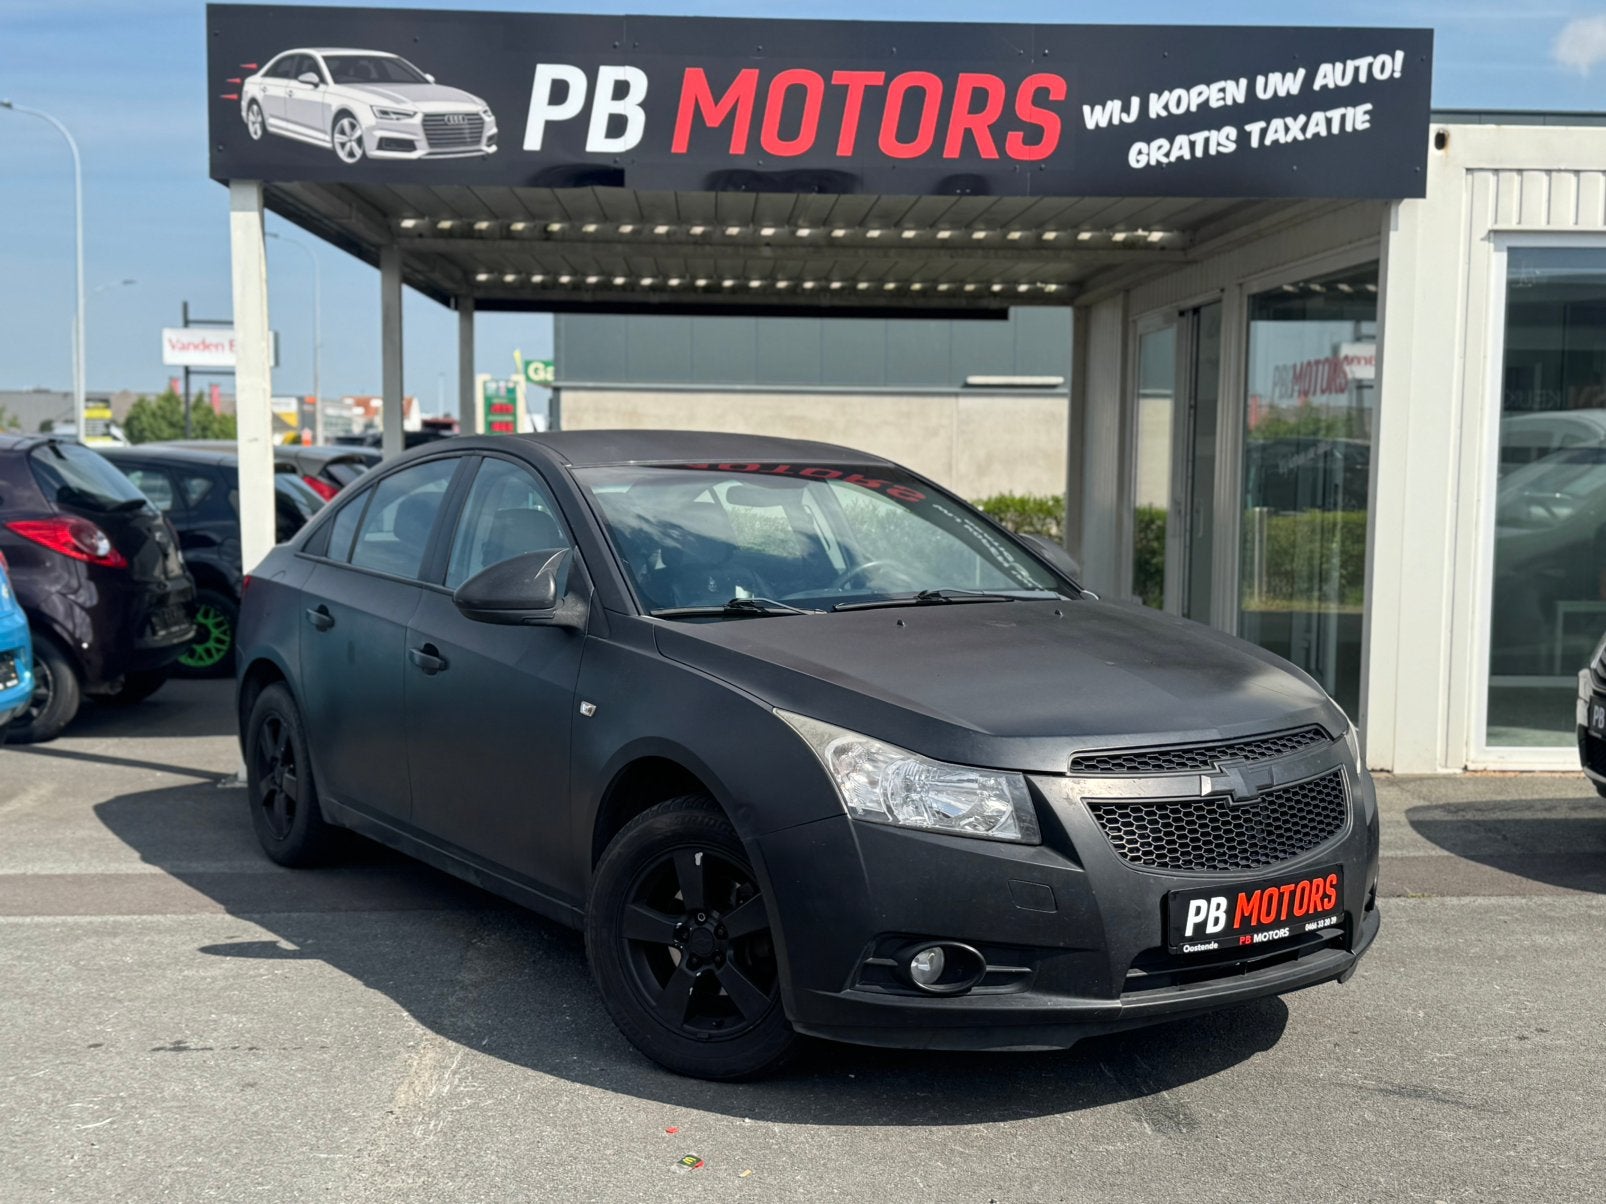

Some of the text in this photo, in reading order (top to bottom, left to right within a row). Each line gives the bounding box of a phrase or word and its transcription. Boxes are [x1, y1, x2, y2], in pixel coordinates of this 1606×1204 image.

[523, 63, 1068, 161] PB MOTORS
[1082, 49, 1405, 130] WIJ KOPEN UW AUTO!
[1128, 102, 1374, 169] GRATIS TAXATIE
[168, 337, 225, 352] Vanden
[1291, 356, 1349, 398] MOTORS
[1593, 705, 1605, 729] PB
[1184, 873, 1338, 937] PB MOTORS
[1183, 941, 1219, 953] Oostende
[1239, 934, 1252, 945] PB
[1253, 928, 1290, 943] MOTORS
